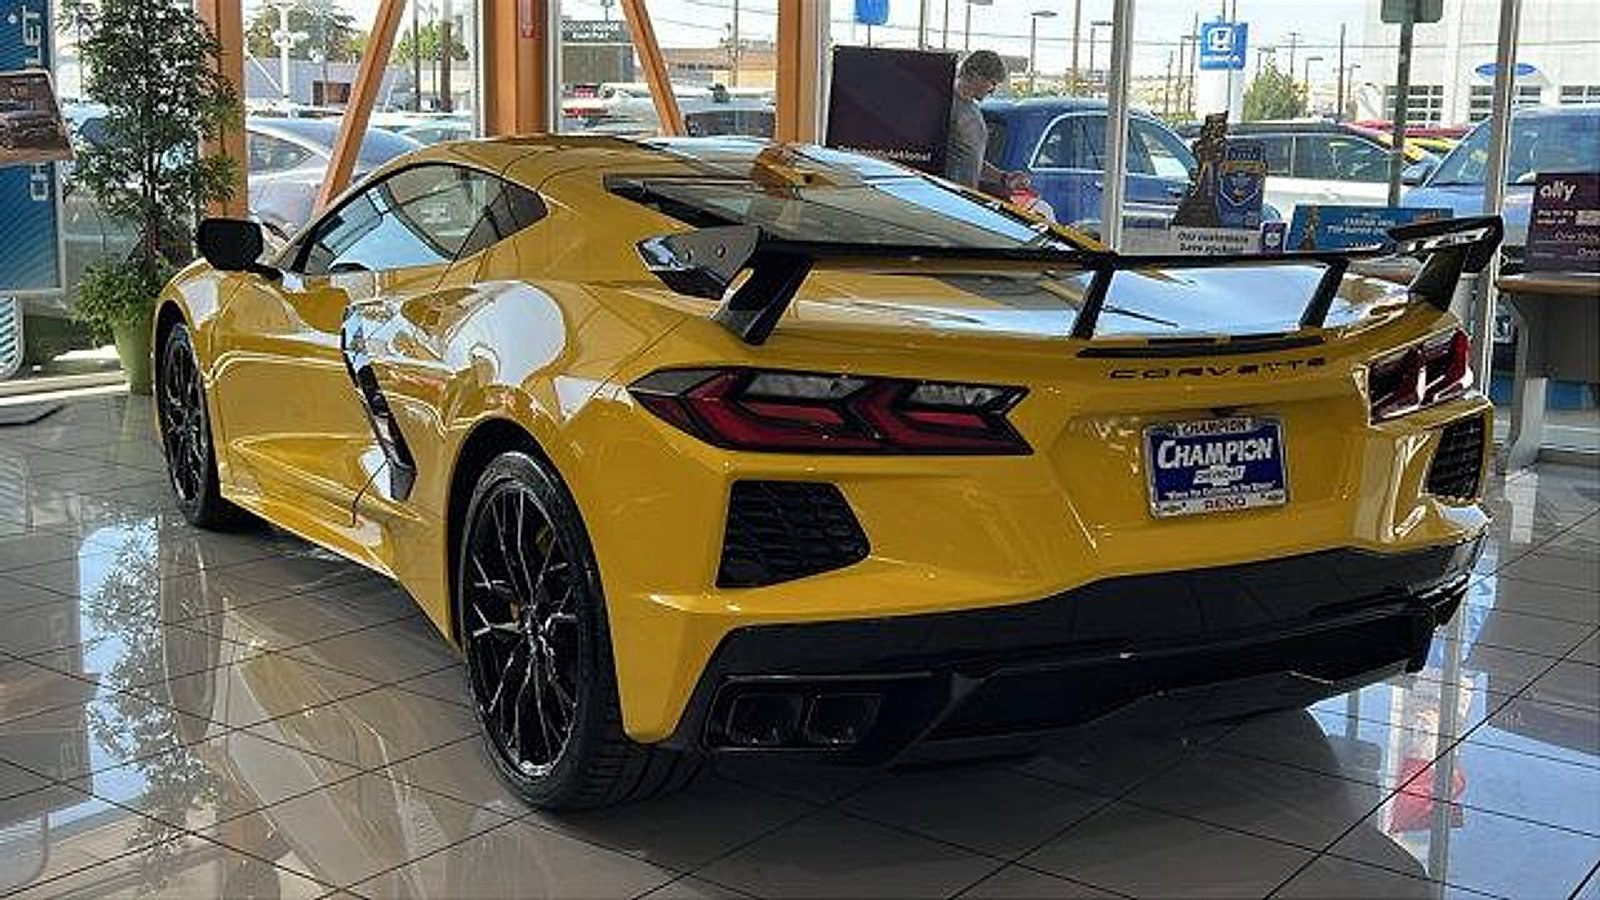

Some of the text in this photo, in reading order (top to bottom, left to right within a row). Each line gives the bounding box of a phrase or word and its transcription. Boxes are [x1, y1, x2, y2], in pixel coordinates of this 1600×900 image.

[1540, 180, 1577, 201] ally
[1110, 357, 1326, 379] CORVETTE
[1157, 437, 1274, 469] CHAMPION
